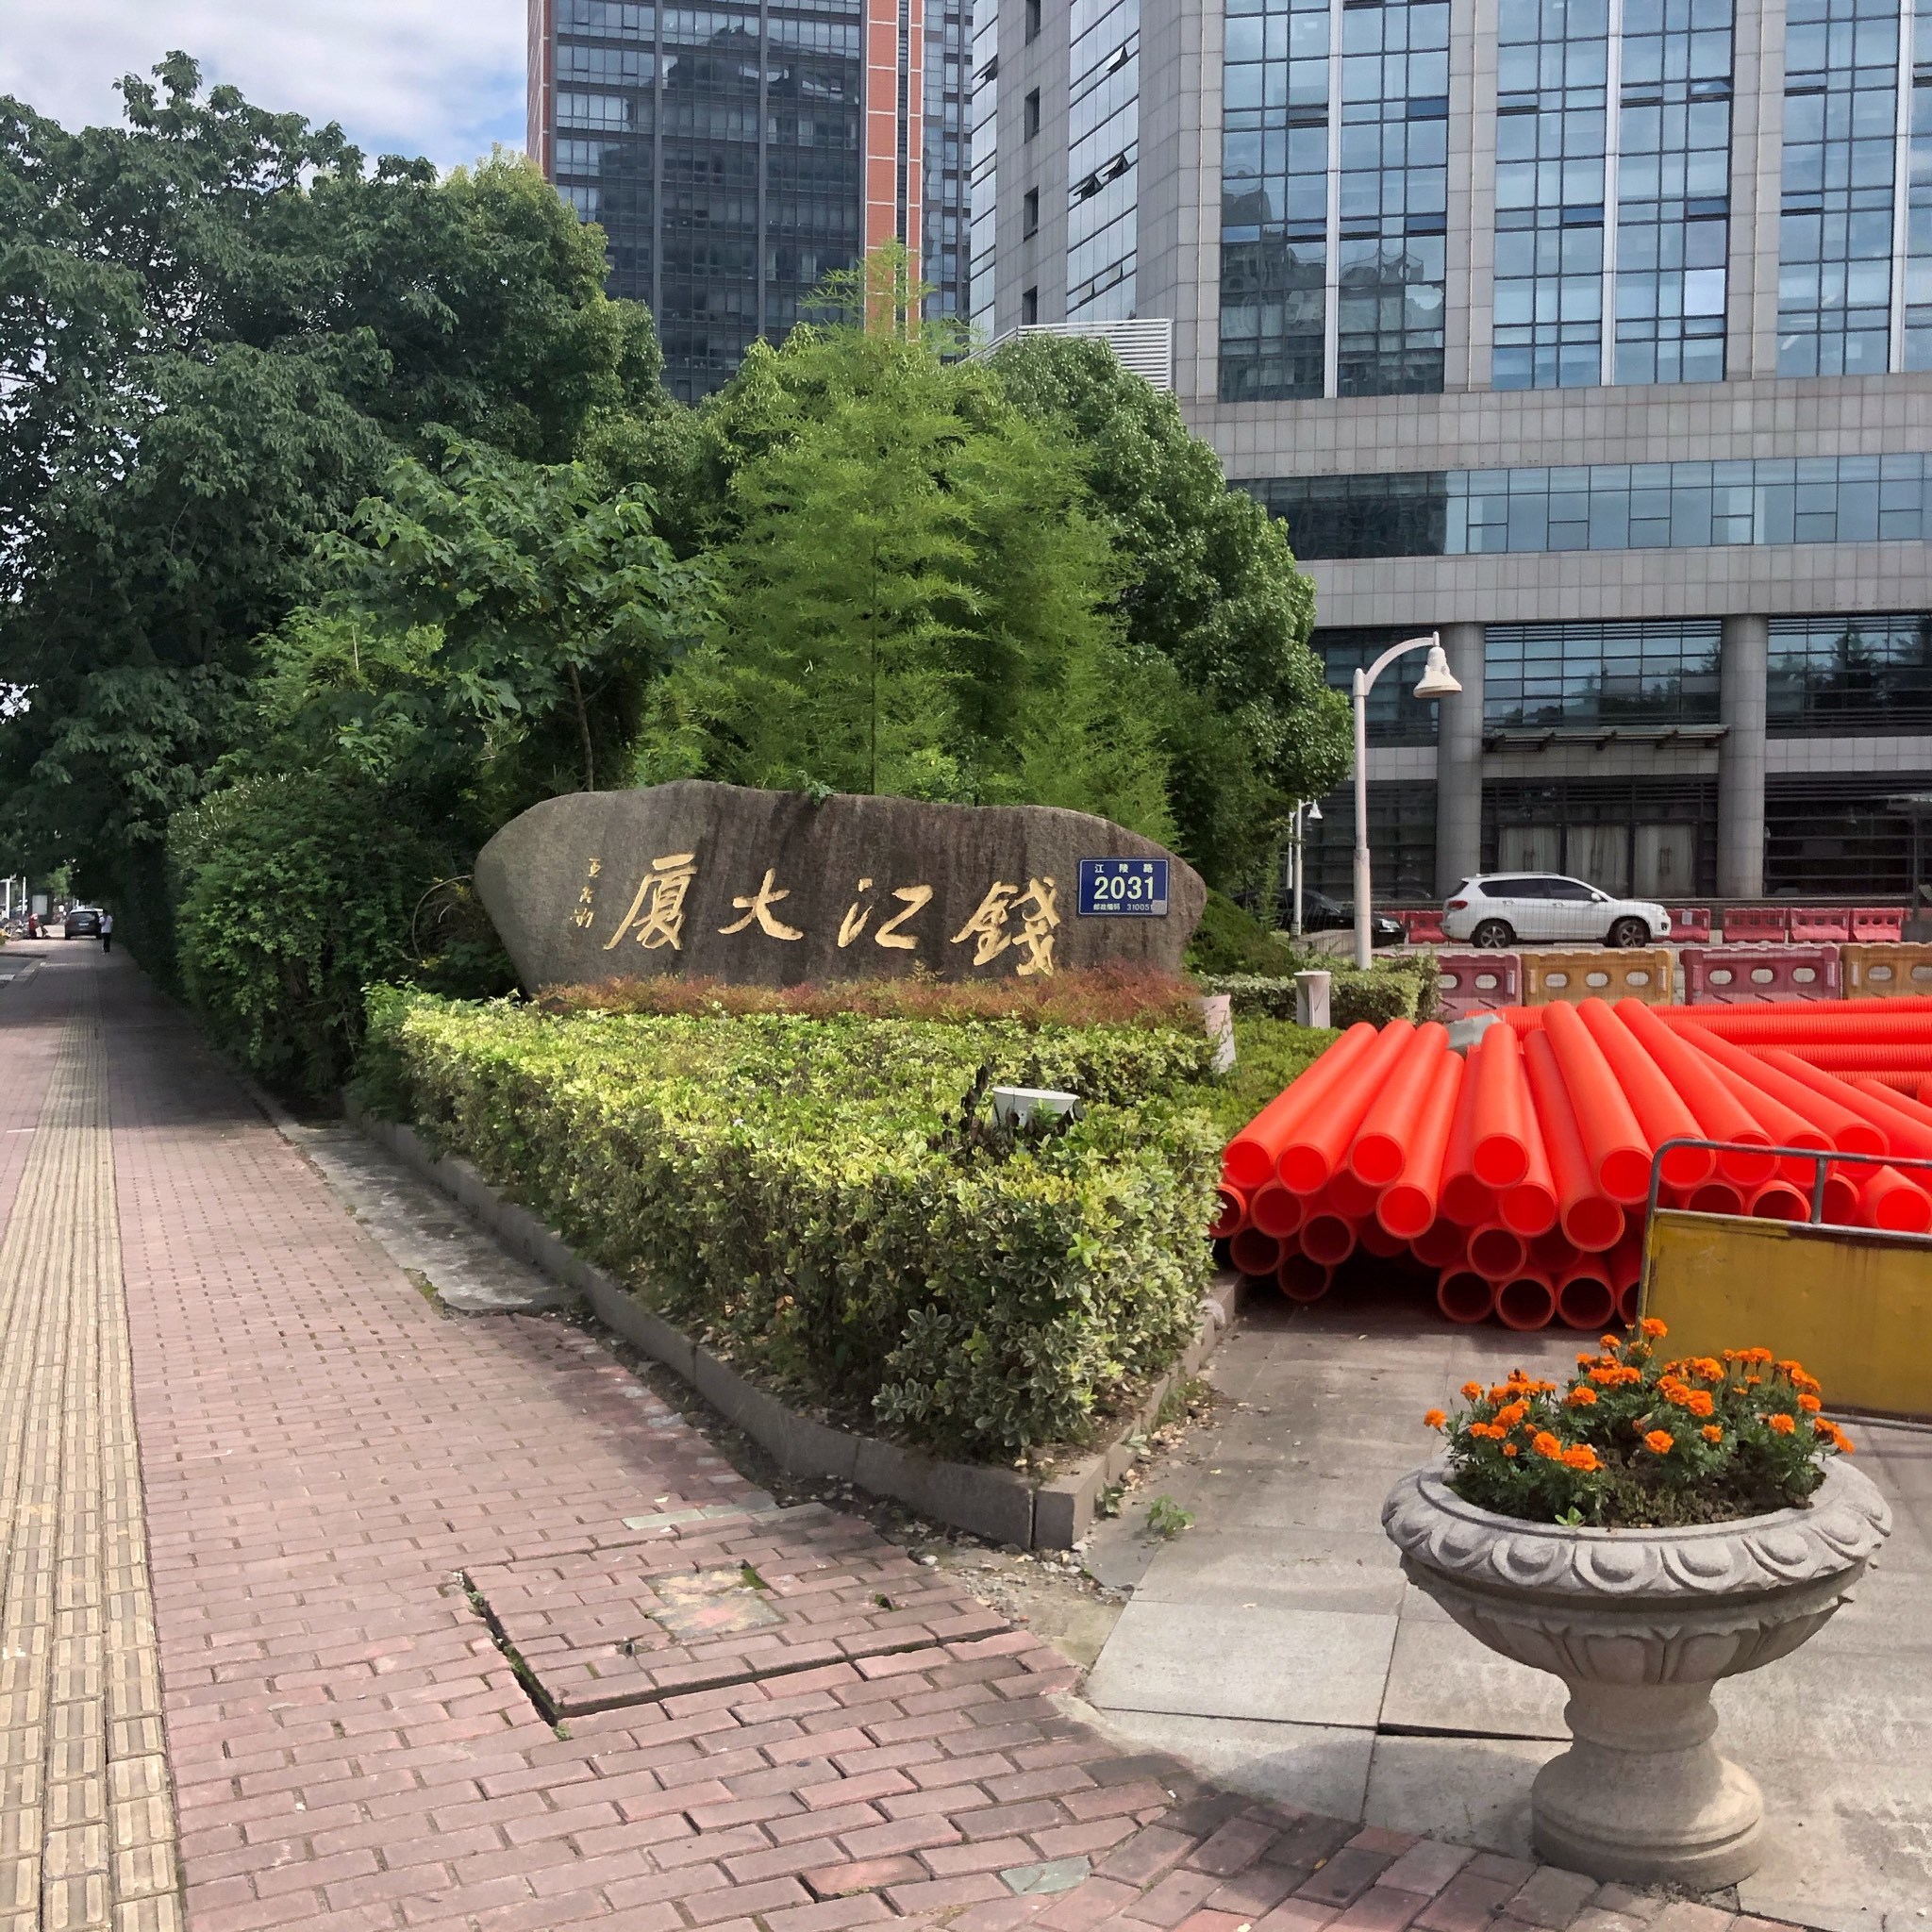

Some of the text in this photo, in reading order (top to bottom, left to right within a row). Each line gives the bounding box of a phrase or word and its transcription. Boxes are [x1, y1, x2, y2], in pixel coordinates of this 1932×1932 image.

[1094, 863, 1154, 874] 江陵路
[1093, 876, 1154, 900] 2031
